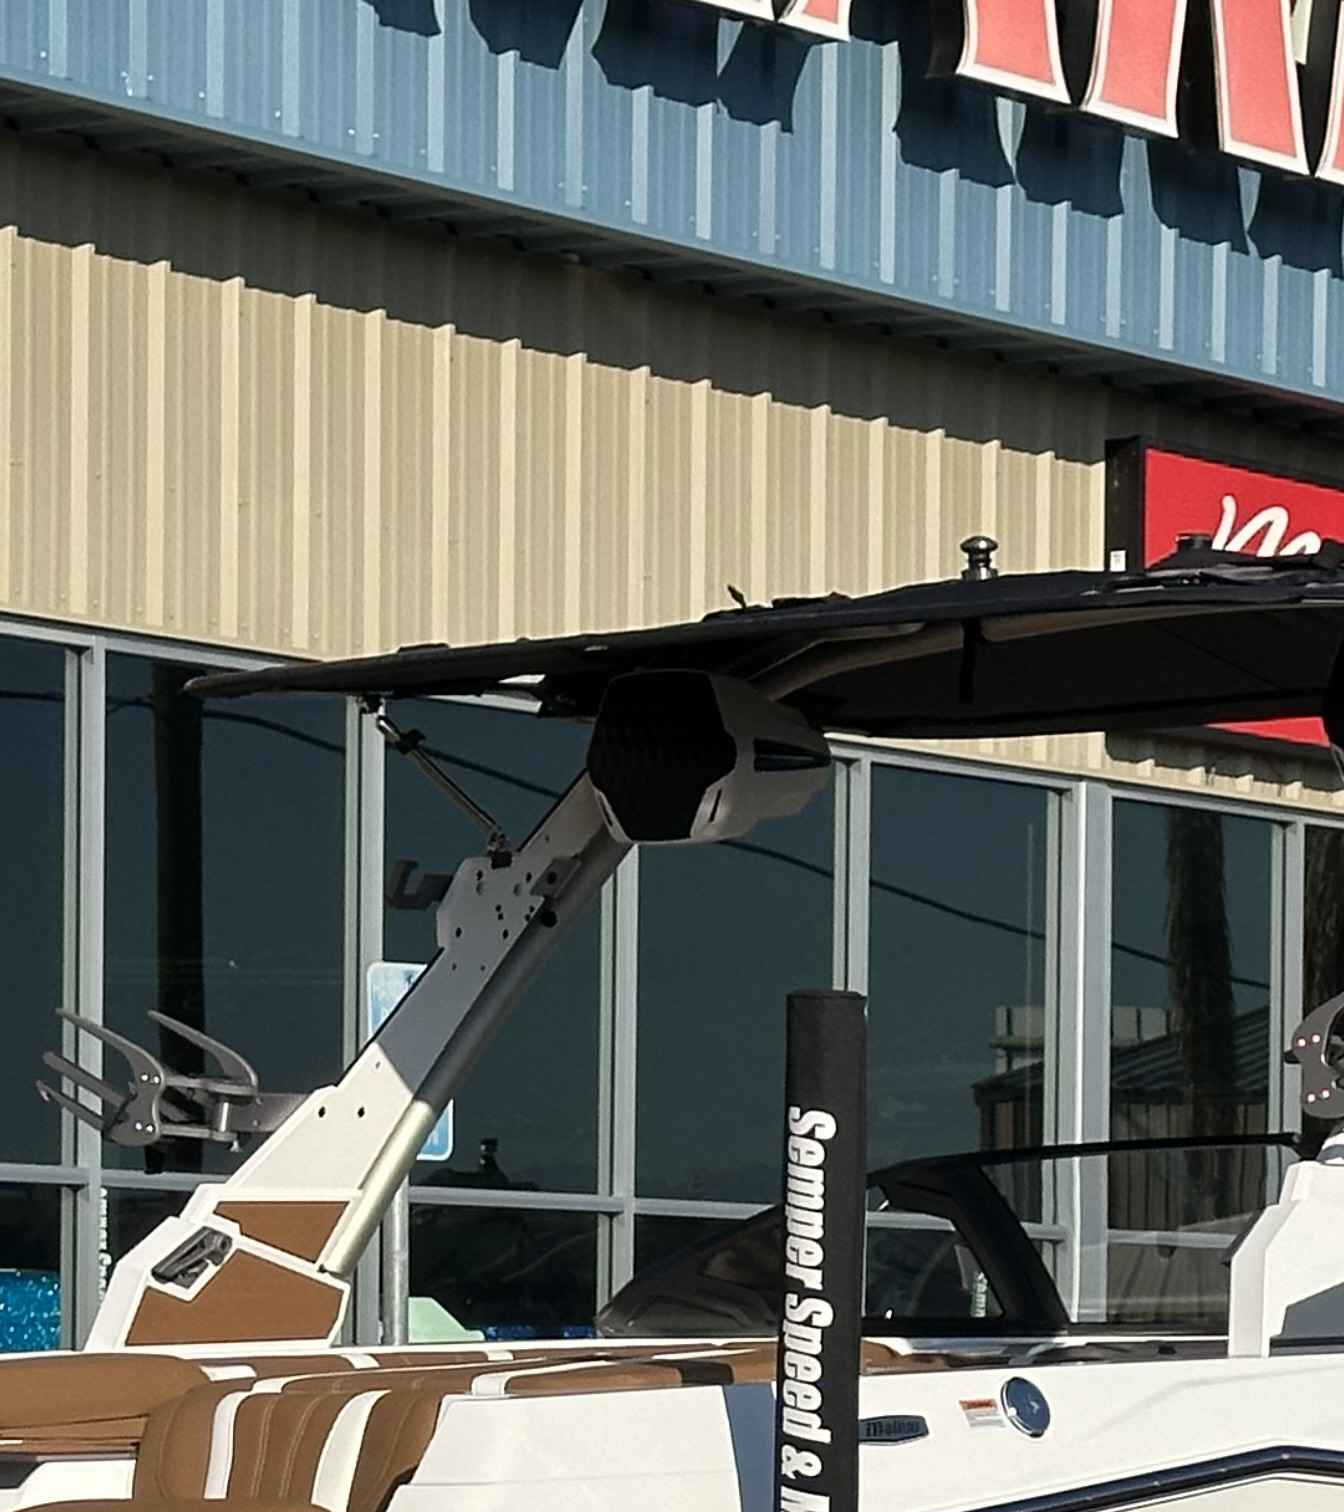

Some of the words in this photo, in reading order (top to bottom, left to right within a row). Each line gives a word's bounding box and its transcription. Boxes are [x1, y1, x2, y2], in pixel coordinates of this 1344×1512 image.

[785, 1106, 837, 1291] Semper
[782, 1293, 834, 1443] Speed
[780, 1444, 822, 1479] &
